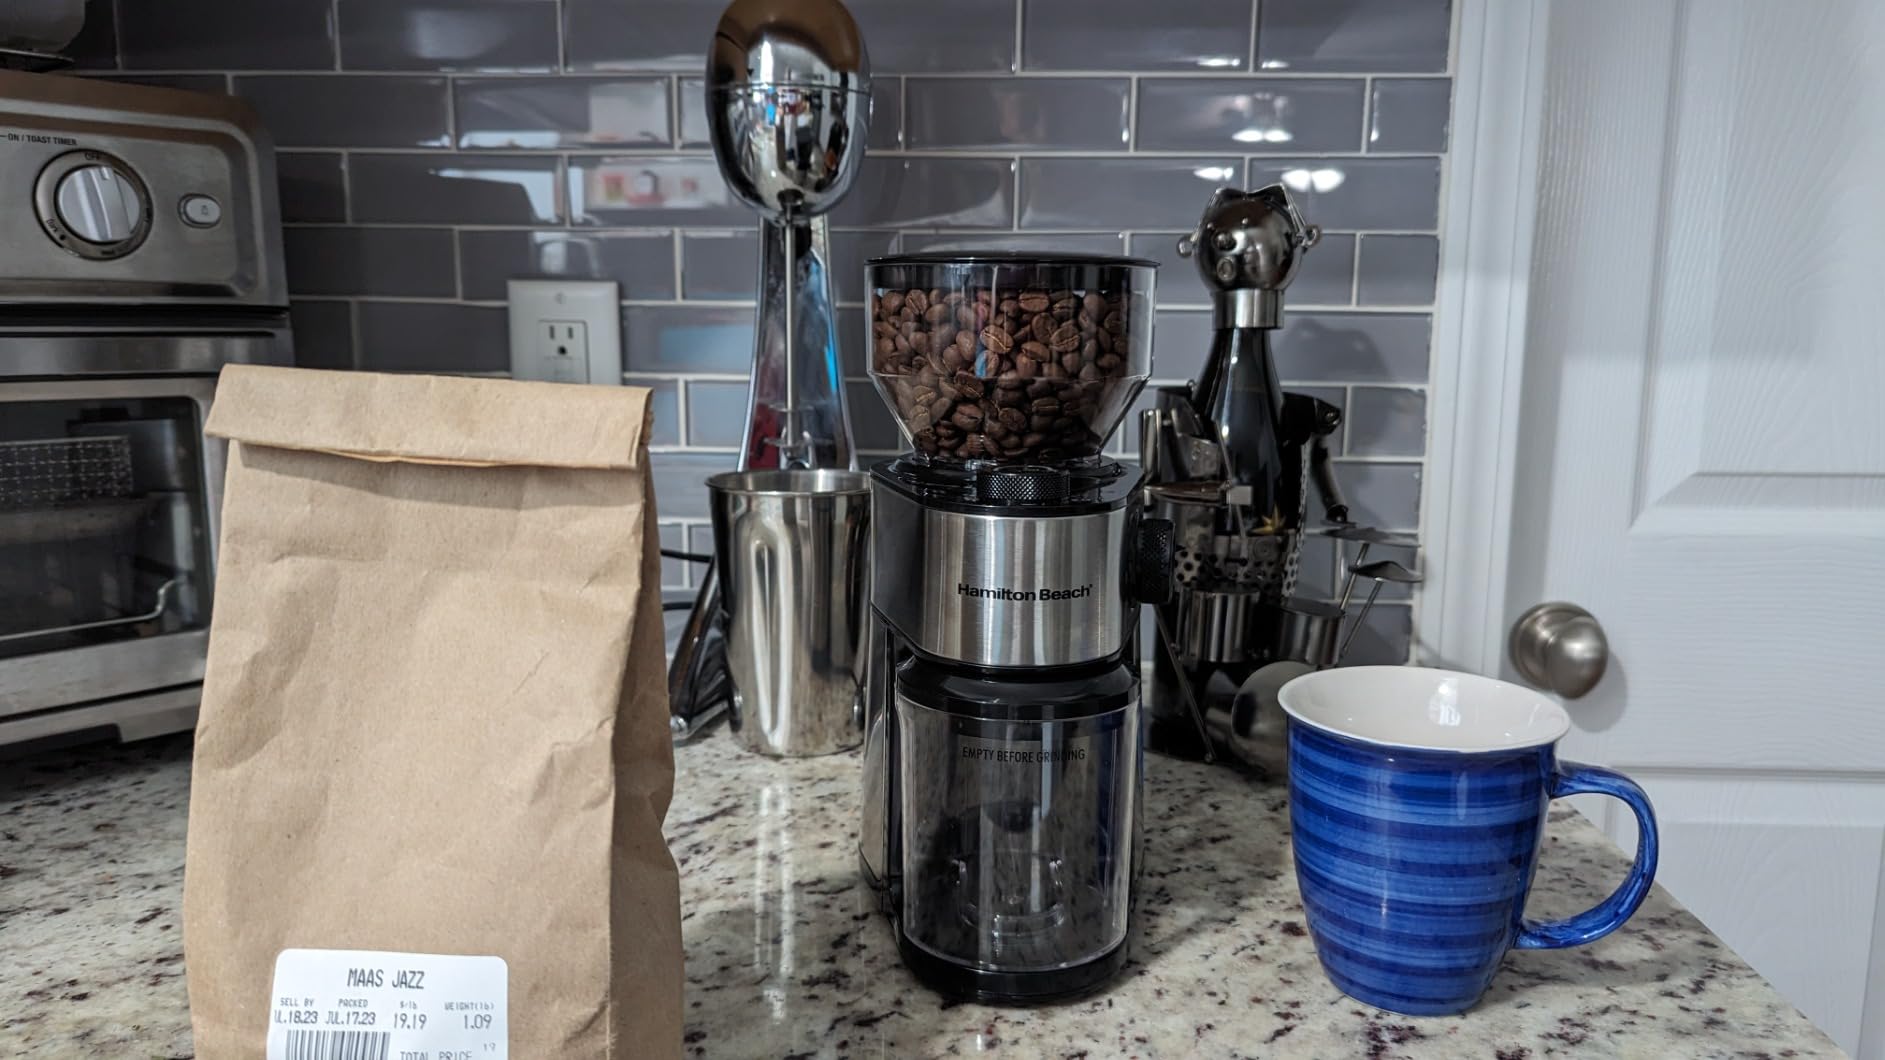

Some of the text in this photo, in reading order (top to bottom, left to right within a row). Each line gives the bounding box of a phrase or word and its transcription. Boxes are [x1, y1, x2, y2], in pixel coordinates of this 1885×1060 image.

[7, 133, 19, 142] ON
[25, 135, 51, 144] TOAST
[53, 137, 78, 145] TIMER
[957, 583, 1090, 601] Hamilton Beach
[962, 746, 994, 761] EMPTY
[997, 750, 1033, 763] BEFORE
[347, 968, 425, 989] MAAS JAZZ
[280, 997, 315, 1008] SELL BY
[338, 998, 369, 1008] PACKED
[325, 1010, 376, 1026] JUL.17.23
[394, 1012, 428, 1030] 19.19
[463, 1013, 492, 1030] 1.09
